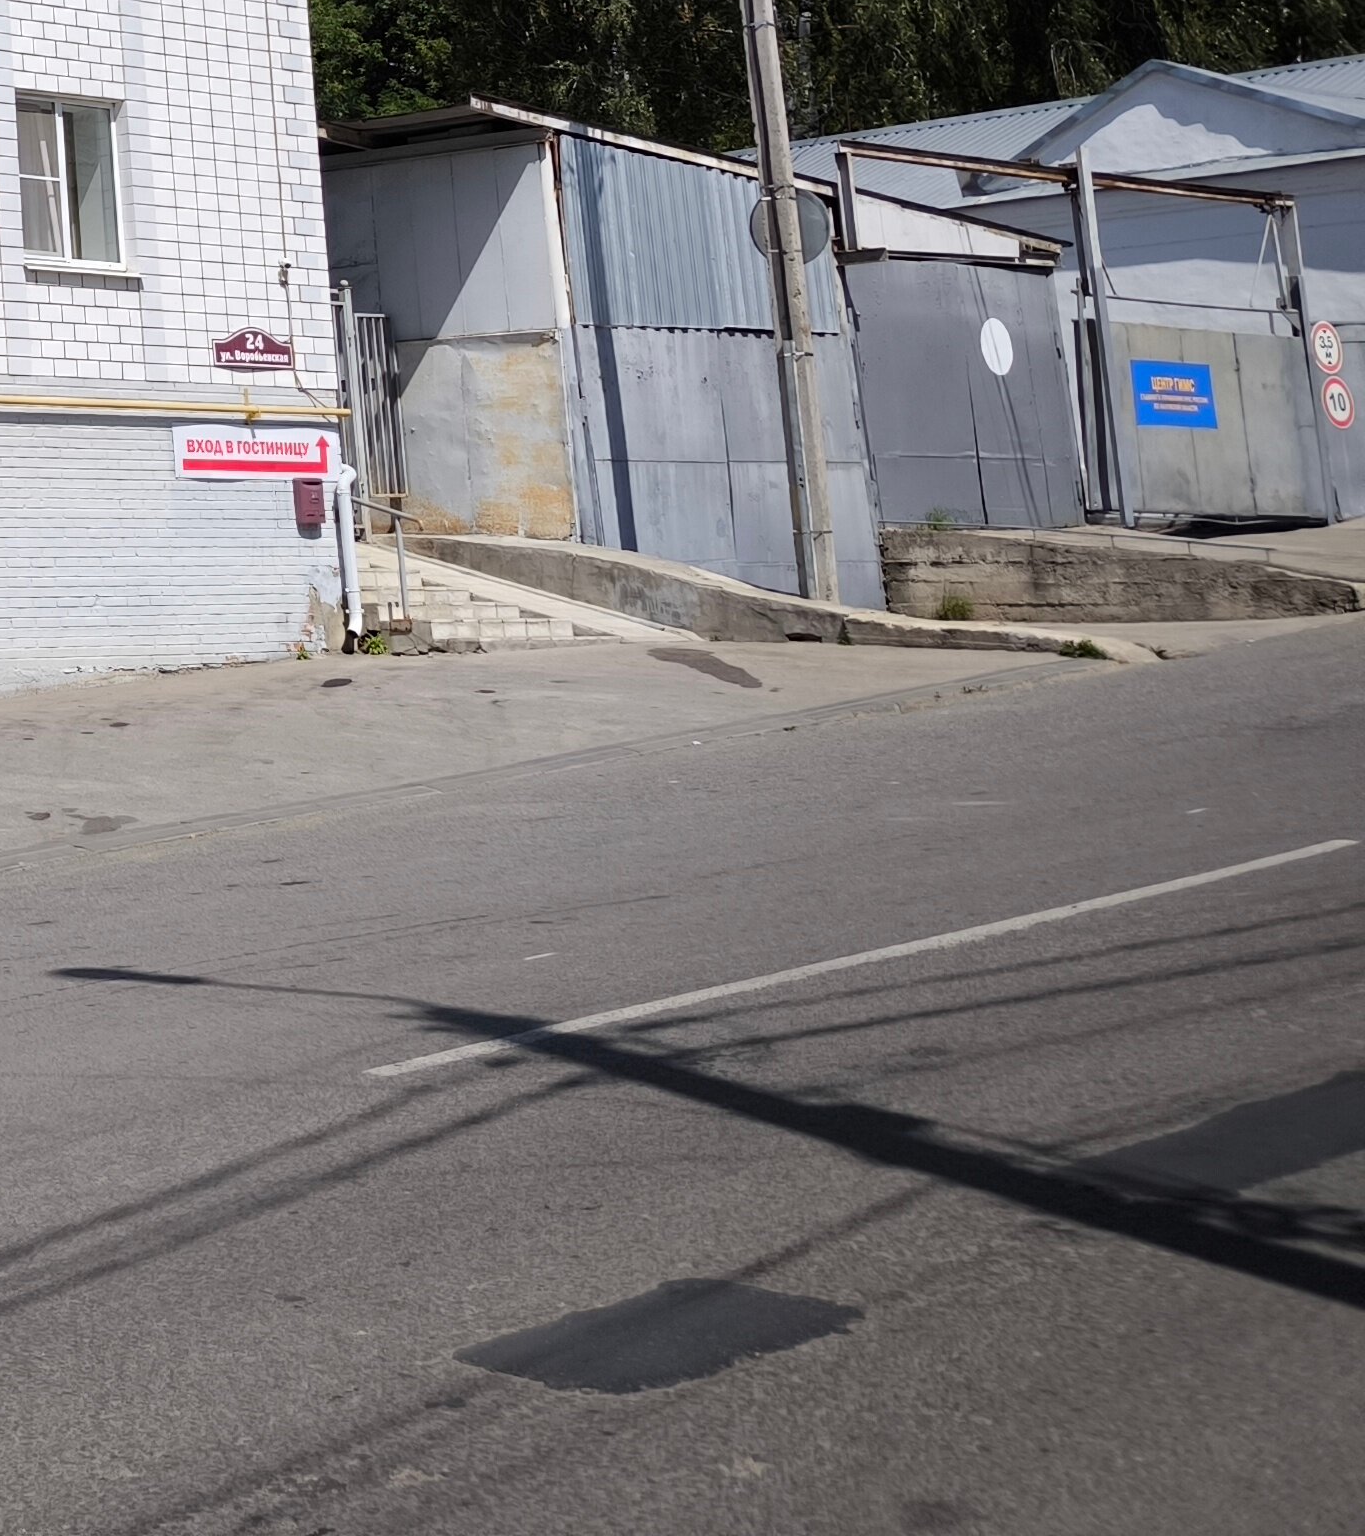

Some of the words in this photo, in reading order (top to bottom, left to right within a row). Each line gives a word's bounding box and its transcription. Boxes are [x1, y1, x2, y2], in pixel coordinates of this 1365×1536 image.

[245, 333, 265, 350] 24
[220, 351, 234, 362] ул.
[1329, 392, 1346, 412] 10
[186, 439, 223, 456] ВХОД
[226, 440, 234, 454] В
[237, 440, 309, 458] ГОСТИНИЦУ
